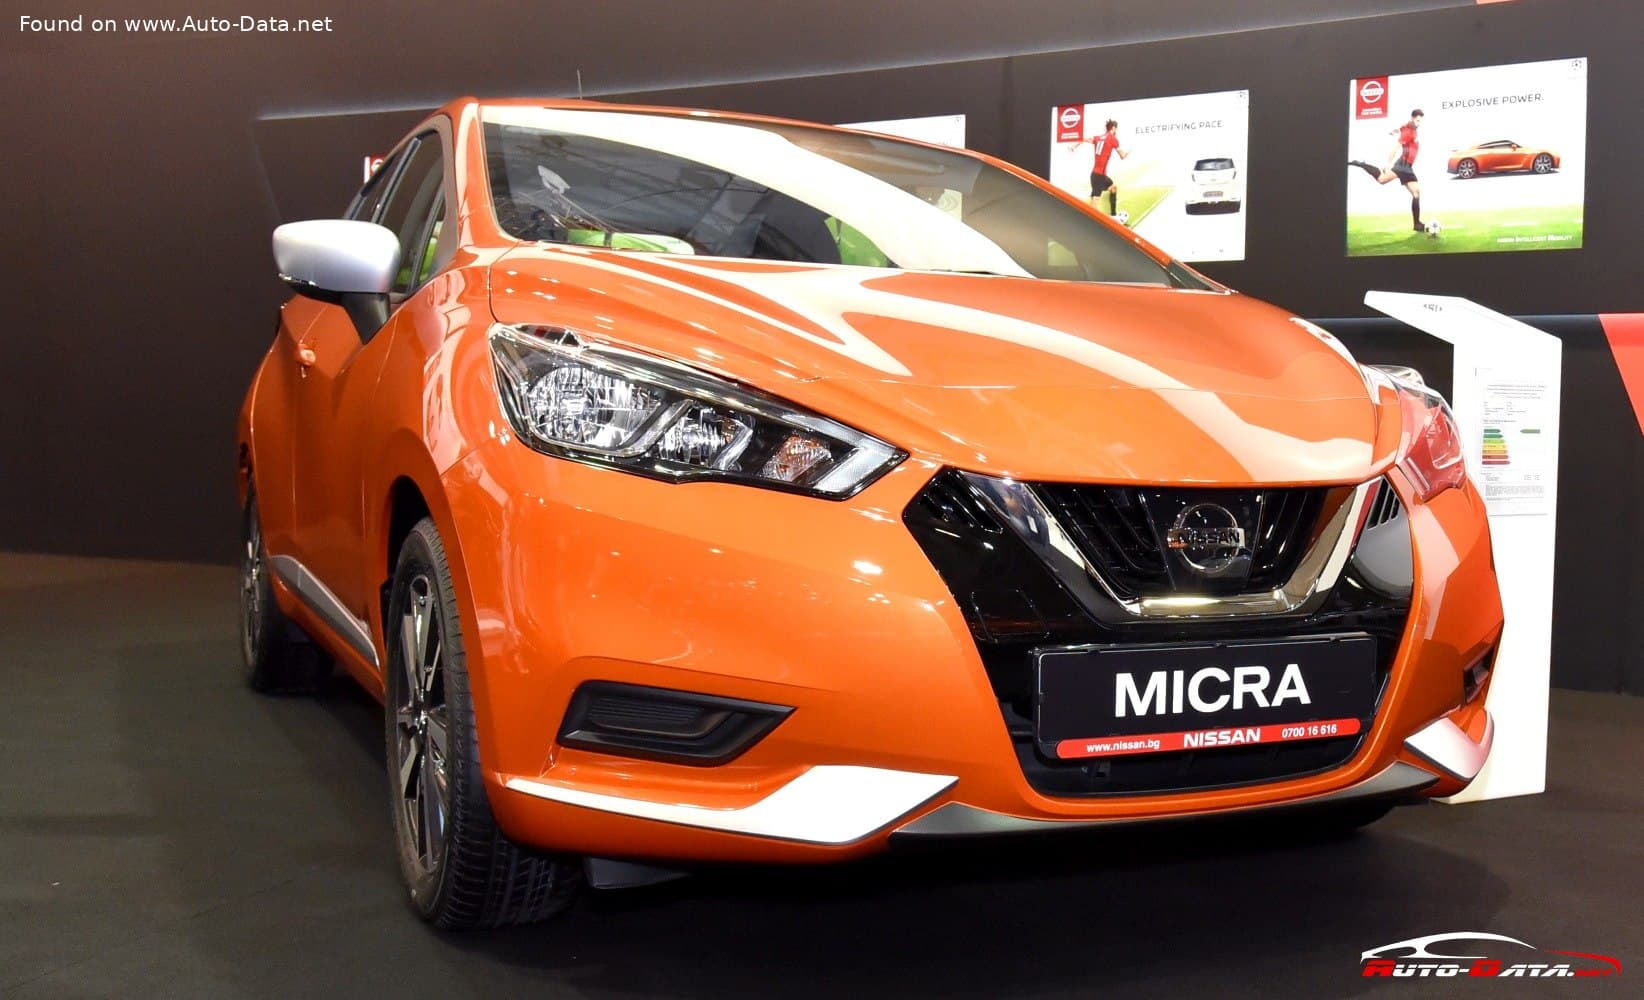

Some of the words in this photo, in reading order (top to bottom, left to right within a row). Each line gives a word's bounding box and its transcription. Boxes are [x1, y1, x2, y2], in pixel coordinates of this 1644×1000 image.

[1441, 96, 1499, 110] EXPLOSIVE
[1135, 122, 1197, 134] ELECTRIFYING
[1115, 663, 1311, 717] MICRA
[1086, 739, 1161, 753] www.nissan.bg
[1183, 727, 1261, 748] NISSAN
[1281, 728, 1305, 739] 0700
[1307, 726, 1319, 736] 16
[1320, 724, 1337, 735] 616
